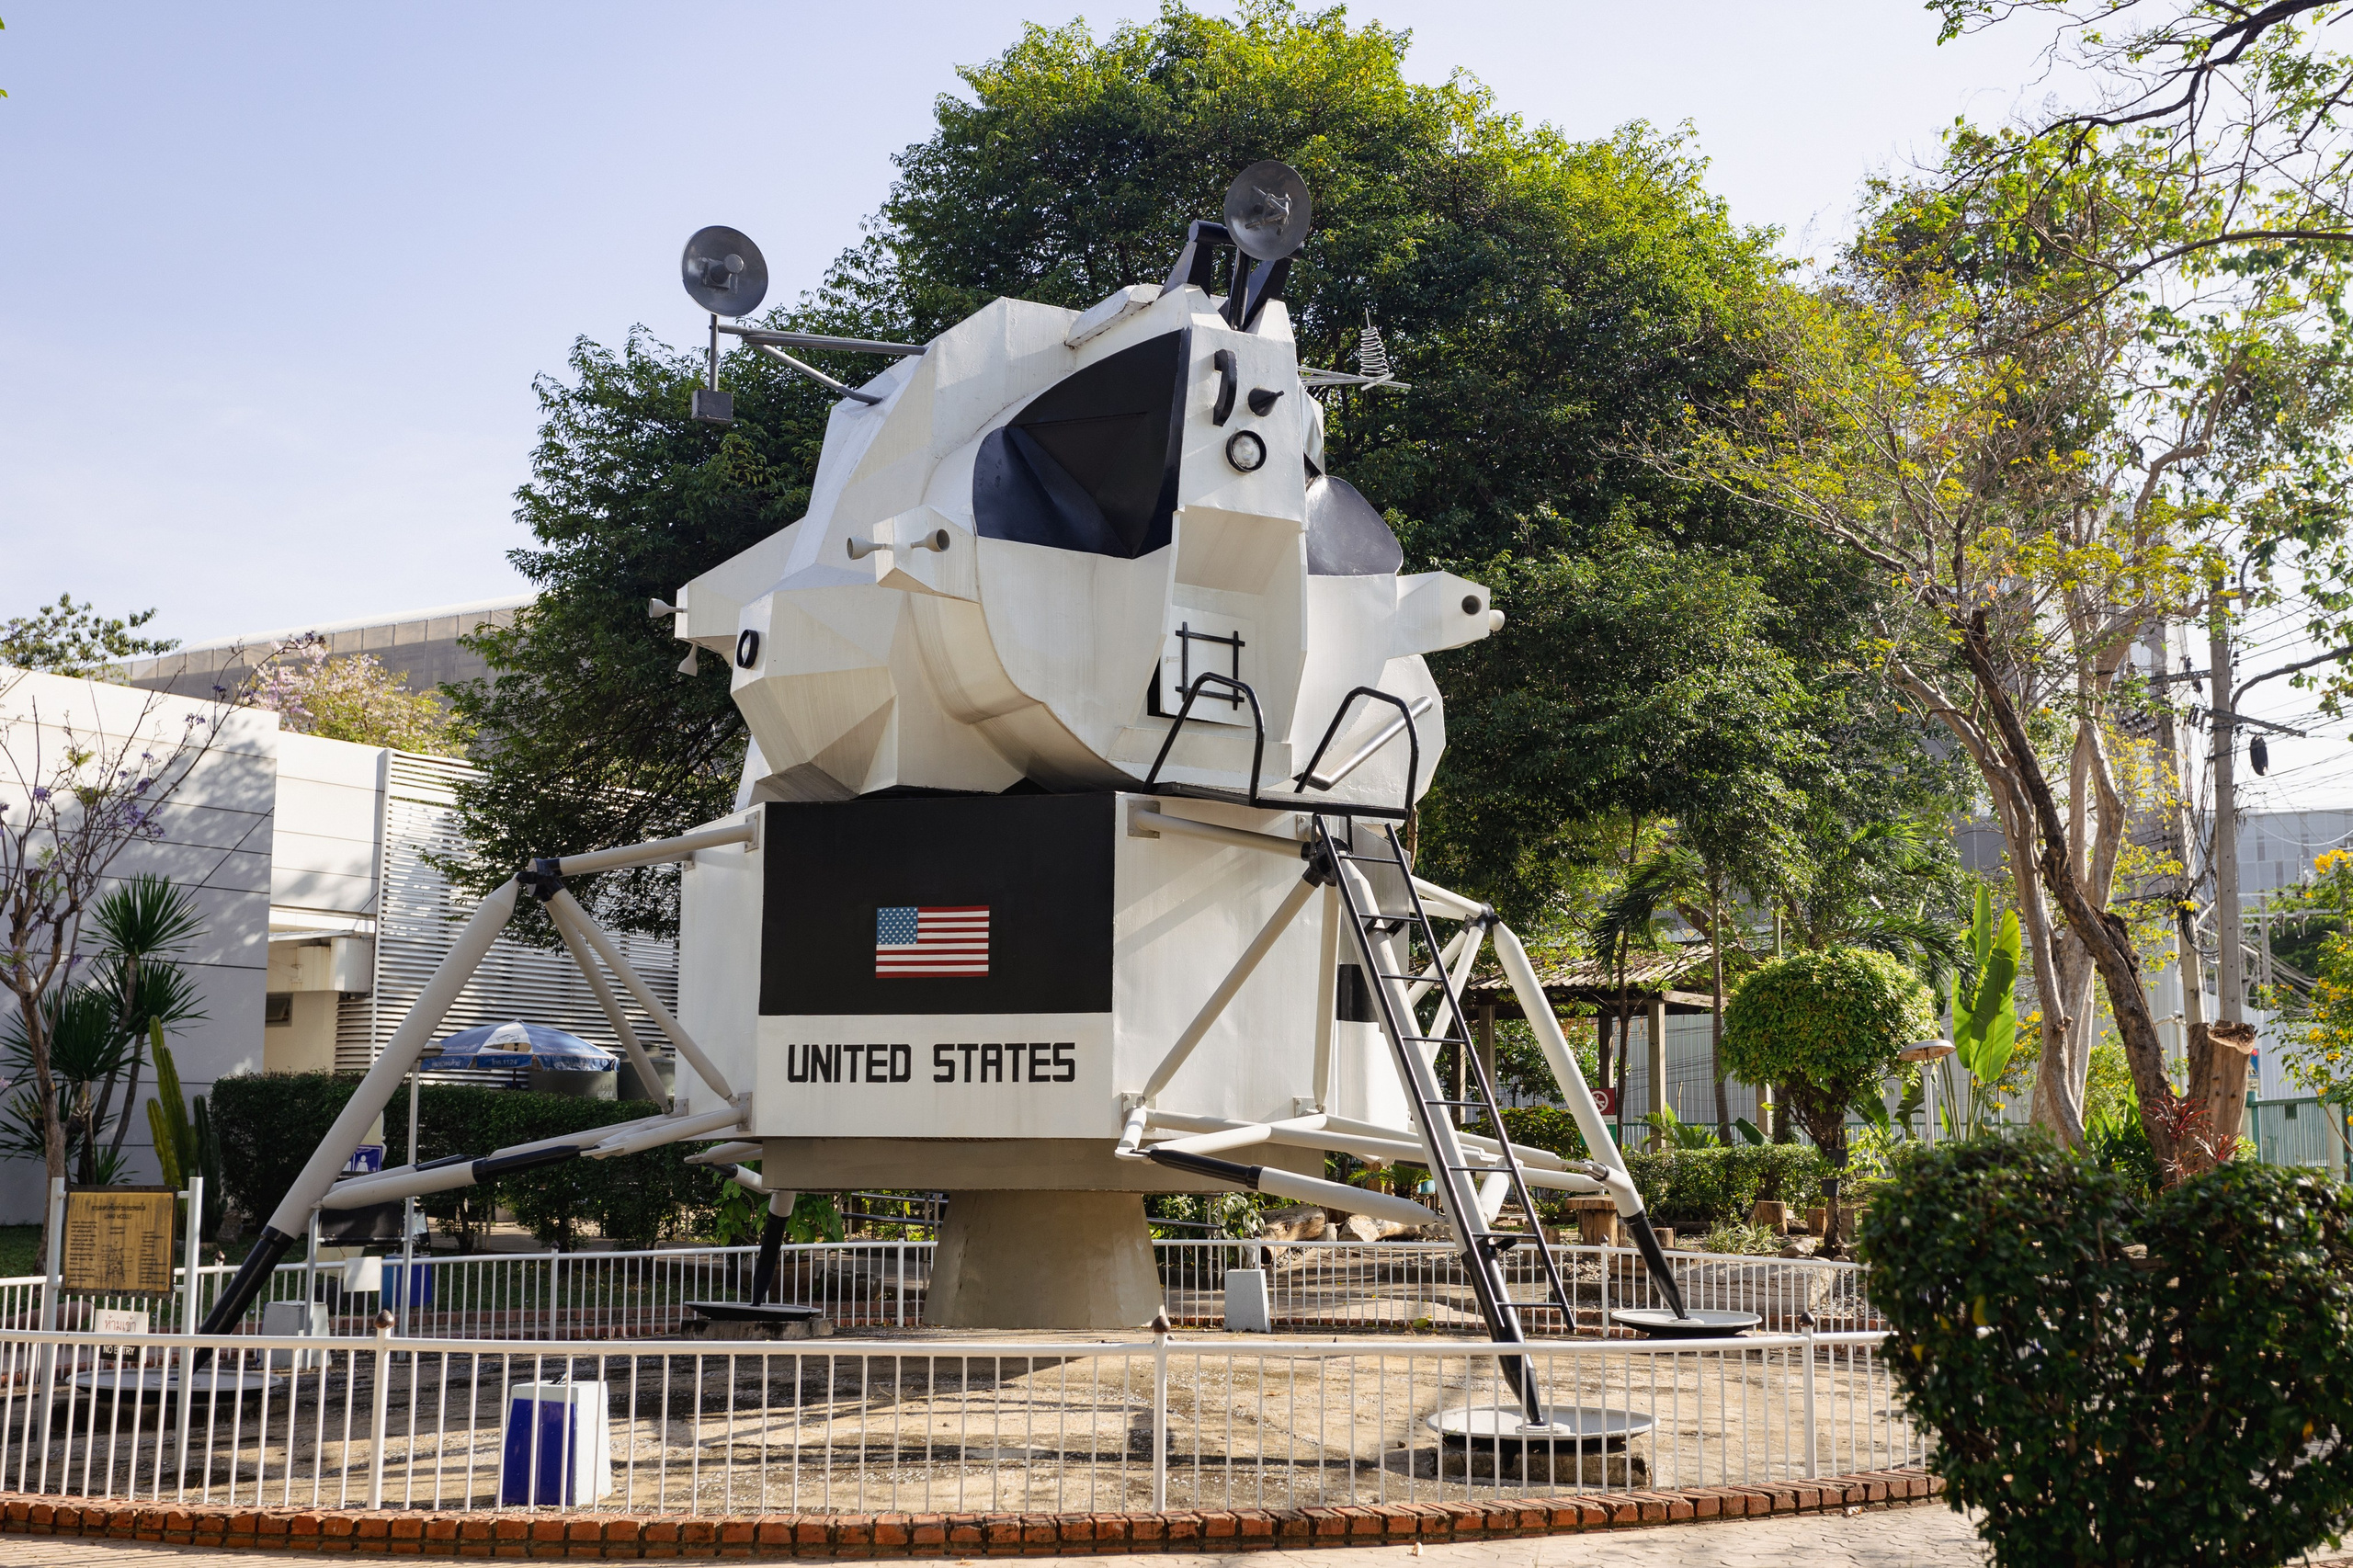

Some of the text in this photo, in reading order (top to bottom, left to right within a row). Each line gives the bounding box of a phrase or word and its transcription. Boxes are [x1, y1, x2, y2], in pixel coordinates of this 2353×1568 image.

[787, 1042, 1075, 1084] UNITED STATES
[104, 1314, 137, 1332] ห้ามเข้า
[103, 1345, 135, 1356] NO ETRY
